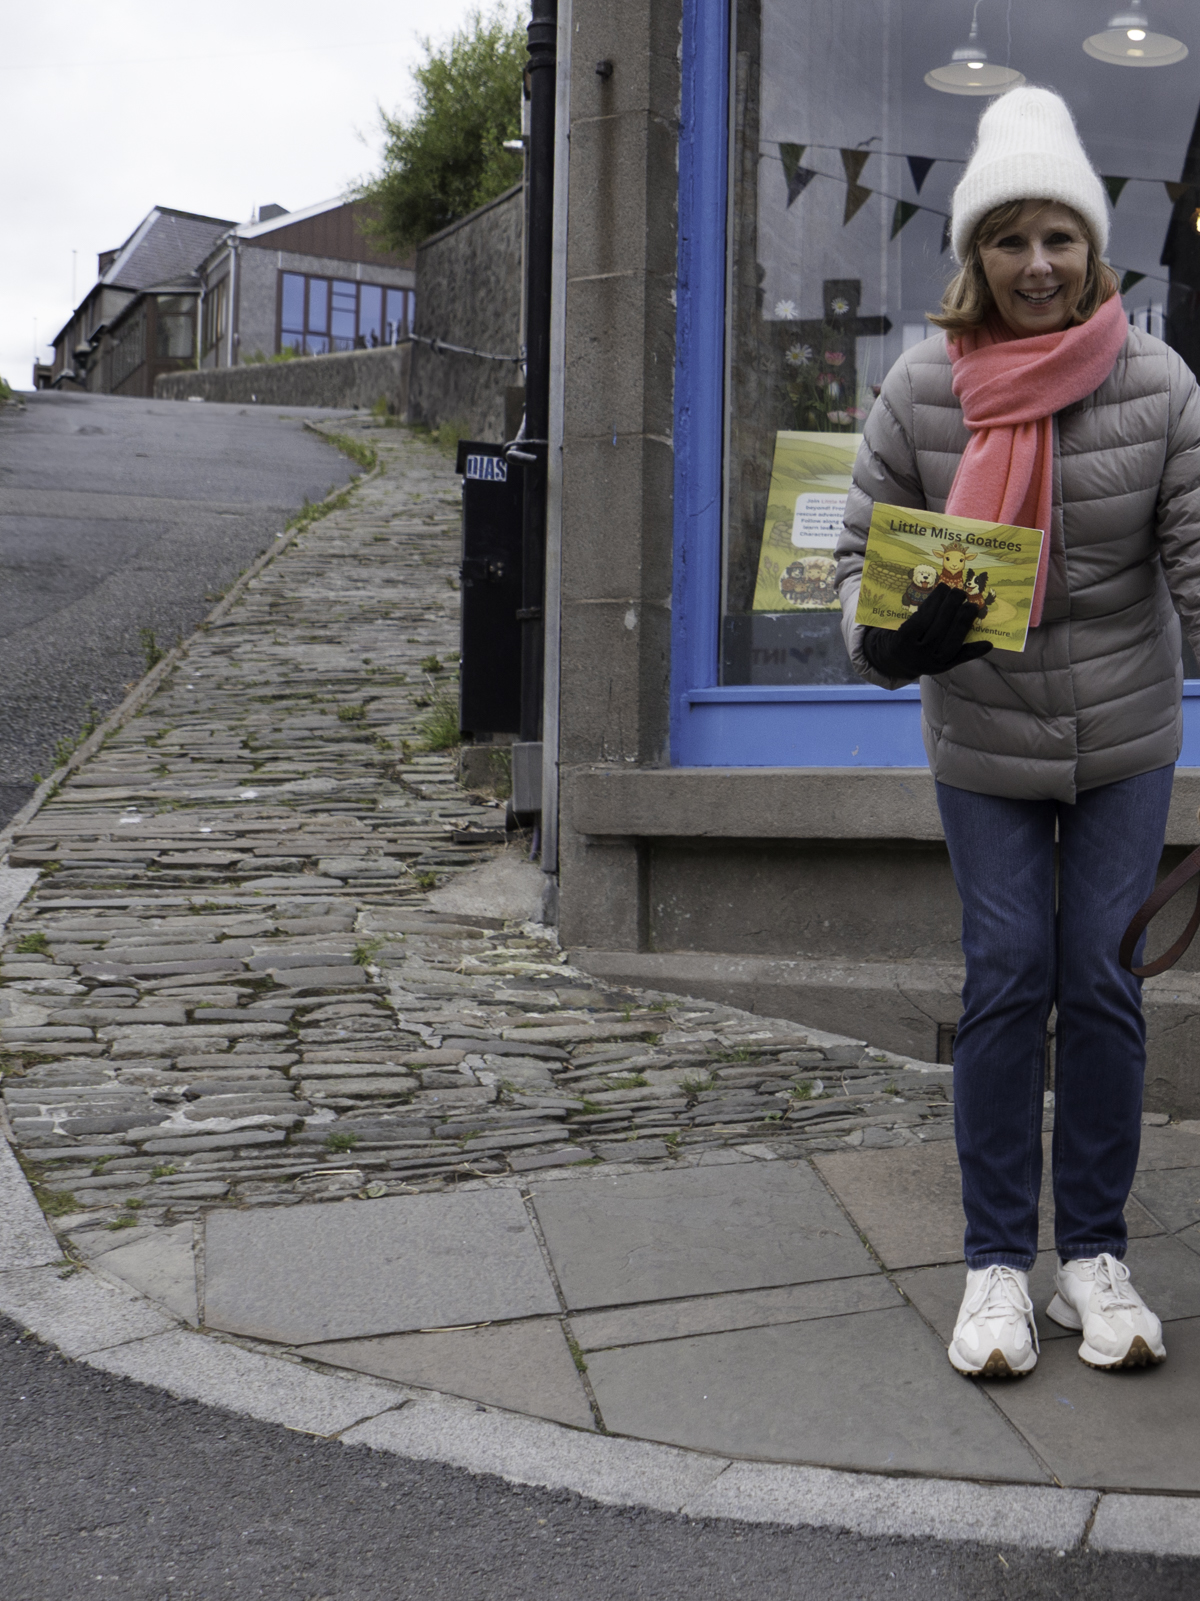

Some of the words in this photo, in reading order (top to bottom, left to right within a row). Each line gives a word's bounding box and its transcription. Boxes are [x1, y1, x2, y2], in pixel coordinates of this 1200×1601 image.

[467, 455, 507, 481] DIAS
[889, 519, 927, 537] Little
[930, 527, 962, 543] Miss
[966, 533, 1022, 553] Goatees
[872, 607, 885, 618] Big
[886, 609, 912, 620] Shetla
